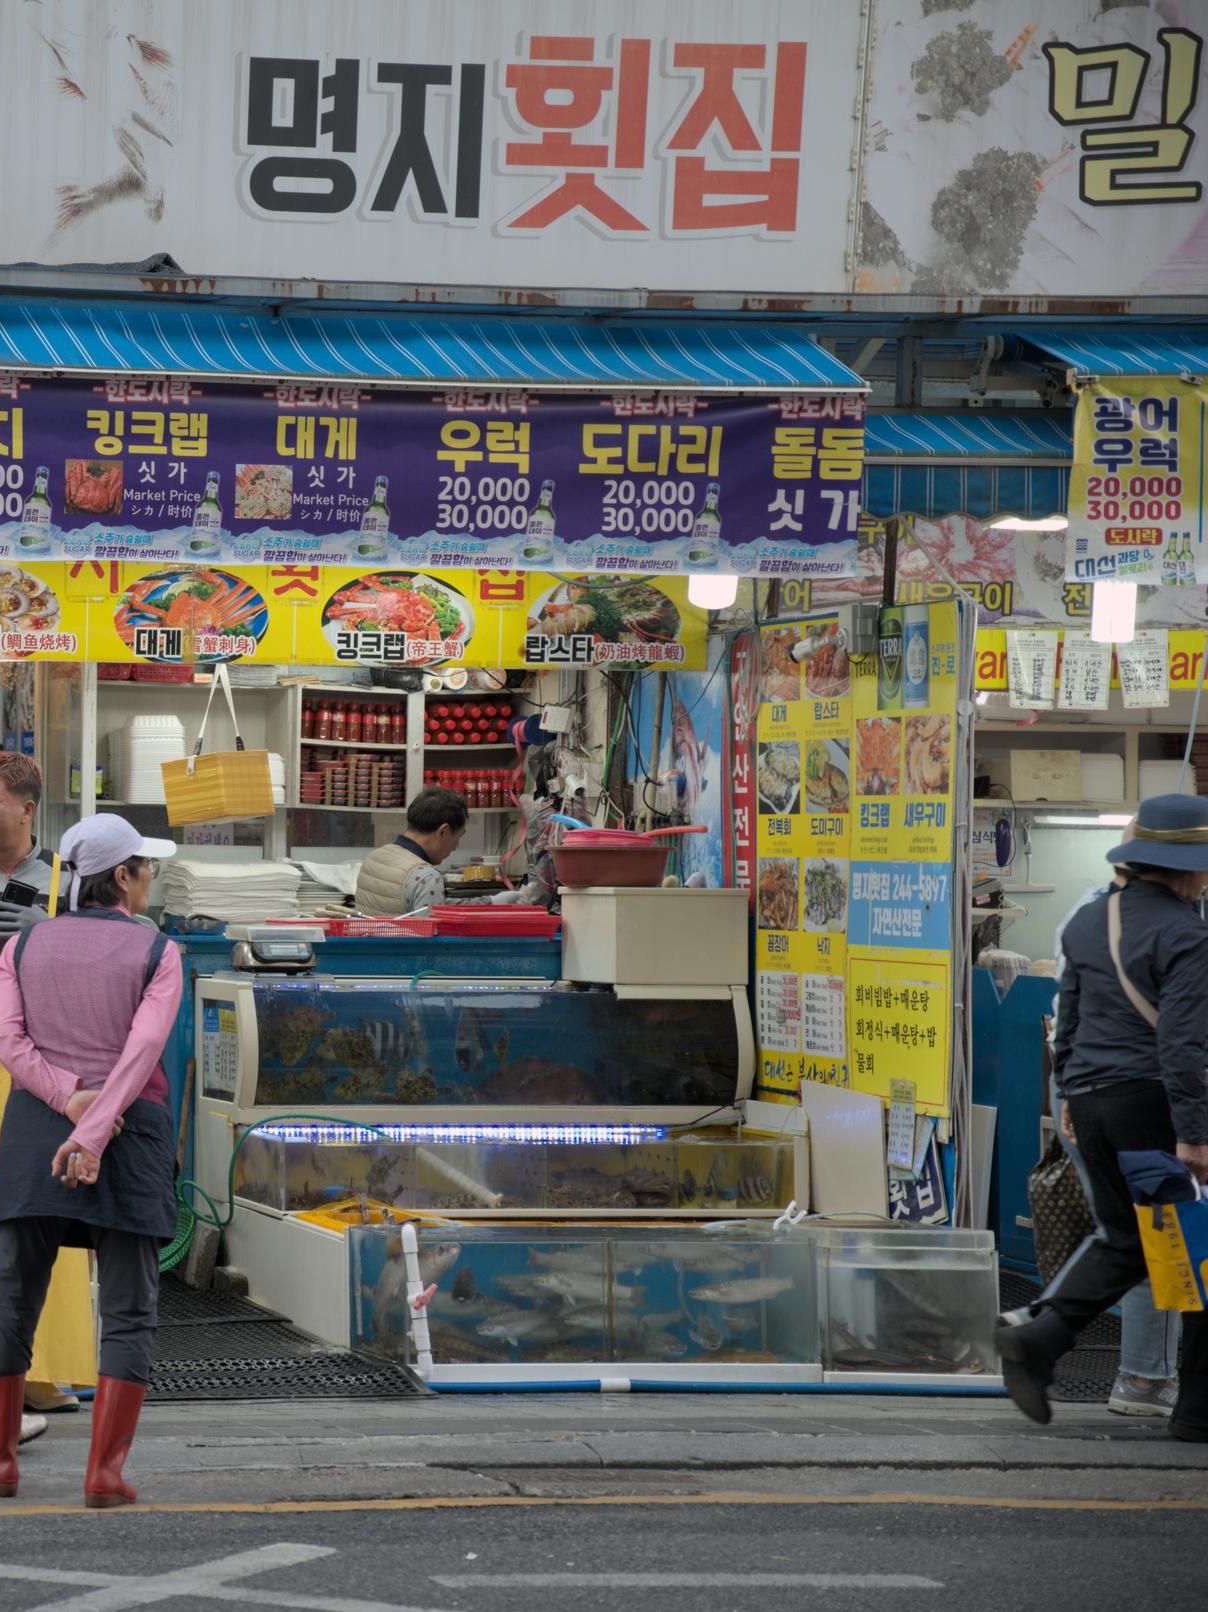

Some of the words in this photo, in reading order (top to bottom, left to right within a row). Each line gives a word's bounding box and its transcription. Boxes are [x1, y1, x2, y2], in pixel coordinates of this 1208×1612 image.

[247, 35, 807, 232] 명지횟집
[1093, 397, 1178, 433] 광어
[86, 409, 208, 457] 킹크랩
[276, 415, 357, 461] 대게
[435, 420, 531, 474] 우럭
[578, 424, 723, 478] 도다리
[771, 426, 865, 480] 돌돔
[1093, 437, 1178, 473] 우럭
[138, 461, 156, 484] 싯
[168, 462, 188, 485] 가
[307, 466, 326, 488] 싯
[338, 466, 356, 489] 가
[123, 488, 166, 502] Market
[170, 489, 201, 503] Price
[293, 492, 334, 506] Market
[338, 494, 369, 507] Price
[437, 476, 530, 505] 20,000
[602, 480, 695, 509] 20,000
[1087, 476, 1182, 500] 20,000
[437, 504, 528, 531] 30,000
[602, 507, 693, 535] 30,000
[768, 488, 804, 531] 싯
[820, 491, 861, 531] 가
[1087, 500, 1182, 523] 30,000
[1110, 530, 1158, 544] 도시락
[95, 546, 137, 558] 깔끔함이
[140, 550, 179, 559] 살아난다!
[1075, 554, 1116, 578] 대선
[1117, 550, 1140, 564] 과당
[135, 628, 182, 657] 대게
[336, 632, 406, 662] 킹크랩
[406, 638, 465, 661] (帝王蟹)
[524, 634, 593, 664] 랍스타
[771, 705, 787, 722] 대게
[814, 702, 840, 720] 랍스타
[767, 818, 792, 836] 전복회
[810, 818, 844, 836] 도미구이
[860, 803, 889, 828] 킹크랩
[904, 802, 946, 828] 새우구이
[852, 872, 890, 901] 명지횟집
[873, 908, 922, 937] 자연산전문
[767, 934, 789, 952] 꼼장어
[817, 936, 831, 955] 낙지
[855, 985, 930, 1012] 회비빔밥+매운탕
[856, 1019, 937, 1048] 회정식+매운탕+밥
